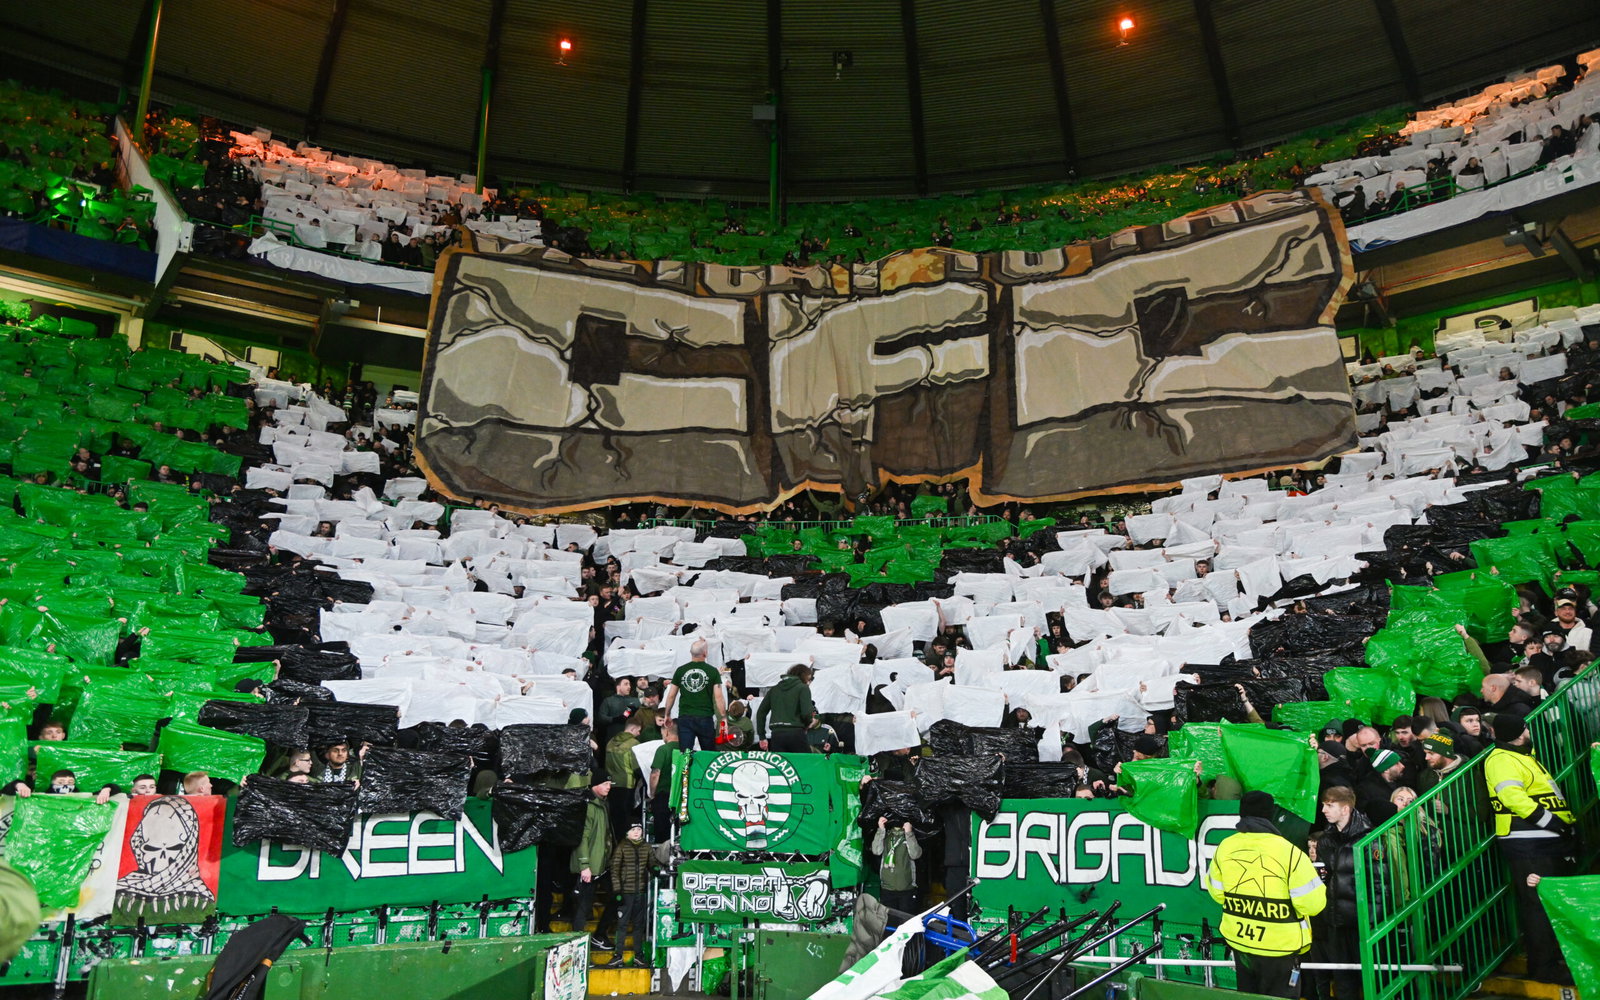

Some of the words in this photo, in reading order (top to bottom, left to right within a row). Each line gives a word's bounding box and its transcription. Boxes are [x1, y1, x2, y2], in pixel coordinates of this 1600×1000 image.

[422, 208, 1352, 442] CFC
[705, 751, 742, 781] GREEN
[747, 751, 800, 785] BRIGADE
[976, 811, 1241, 892] BRIGADE
[682, 872, 782, 893] DIFFIDATI
[692, 893, 737, 913] CON
[1222, 897, 1290, 919] TEWARD
[1236, 921, 1266, 942] 247
